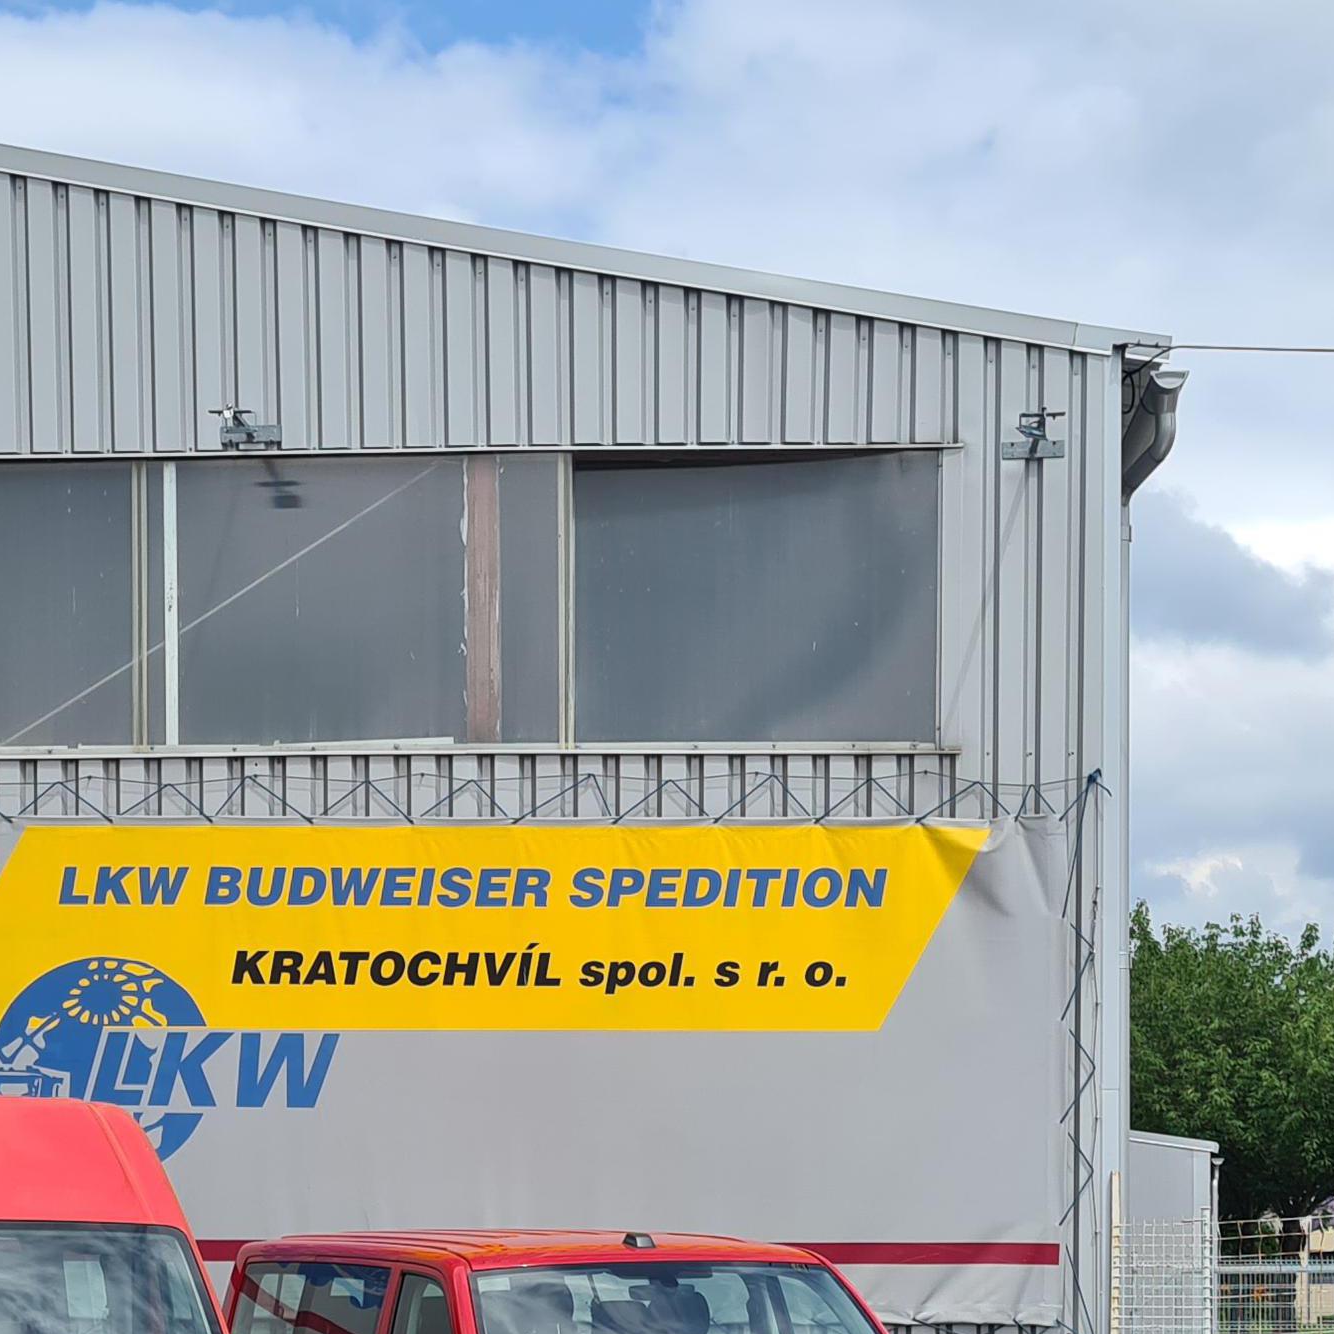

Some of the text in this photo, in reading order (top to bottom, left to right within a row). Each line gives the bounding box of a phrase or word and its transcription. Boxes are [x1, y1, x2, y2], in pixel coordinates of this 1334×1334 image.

[59, 866, 888, 908] LKW BUDWEISER SPEDITION
[231, 943, 845, 994] KRATOCHVÍL spol. s r. o.
[89, 1031, 341, 1108] LKW
